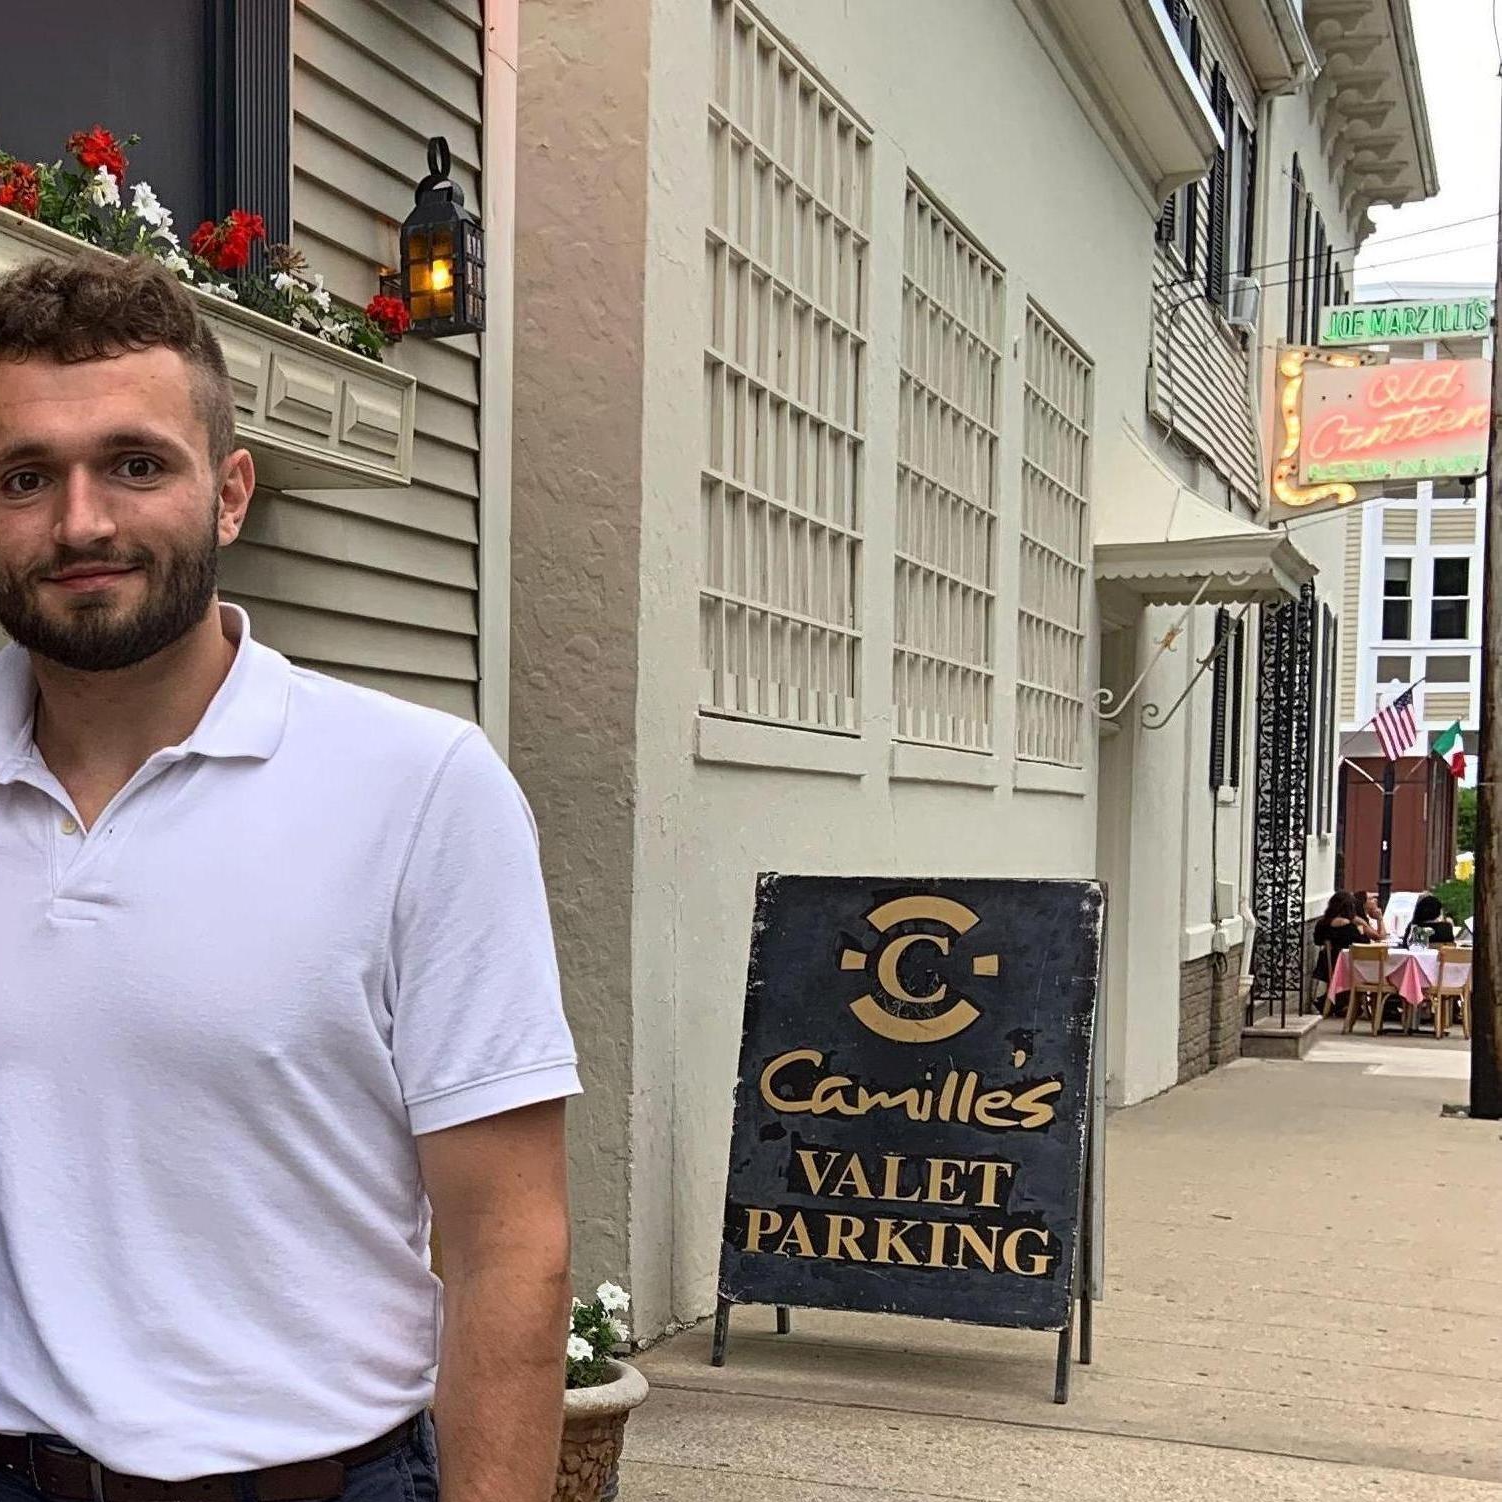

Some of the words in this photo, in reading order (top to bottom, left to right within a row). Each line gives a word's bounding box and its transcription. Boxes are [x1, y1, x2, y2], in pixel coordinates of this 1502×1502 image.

[1323, 311, 1365, 341] JOE
[1368, 364, 1465, 408] Old
[1308, 403, 1487, 459] Canteen
[877, 934, 950, 1003] C
[759, 1049, 1062, 1129] Camille's
[795, 1149, 1013, 1208] VALET
[741, 1207, 1055, 1277] PARKING
